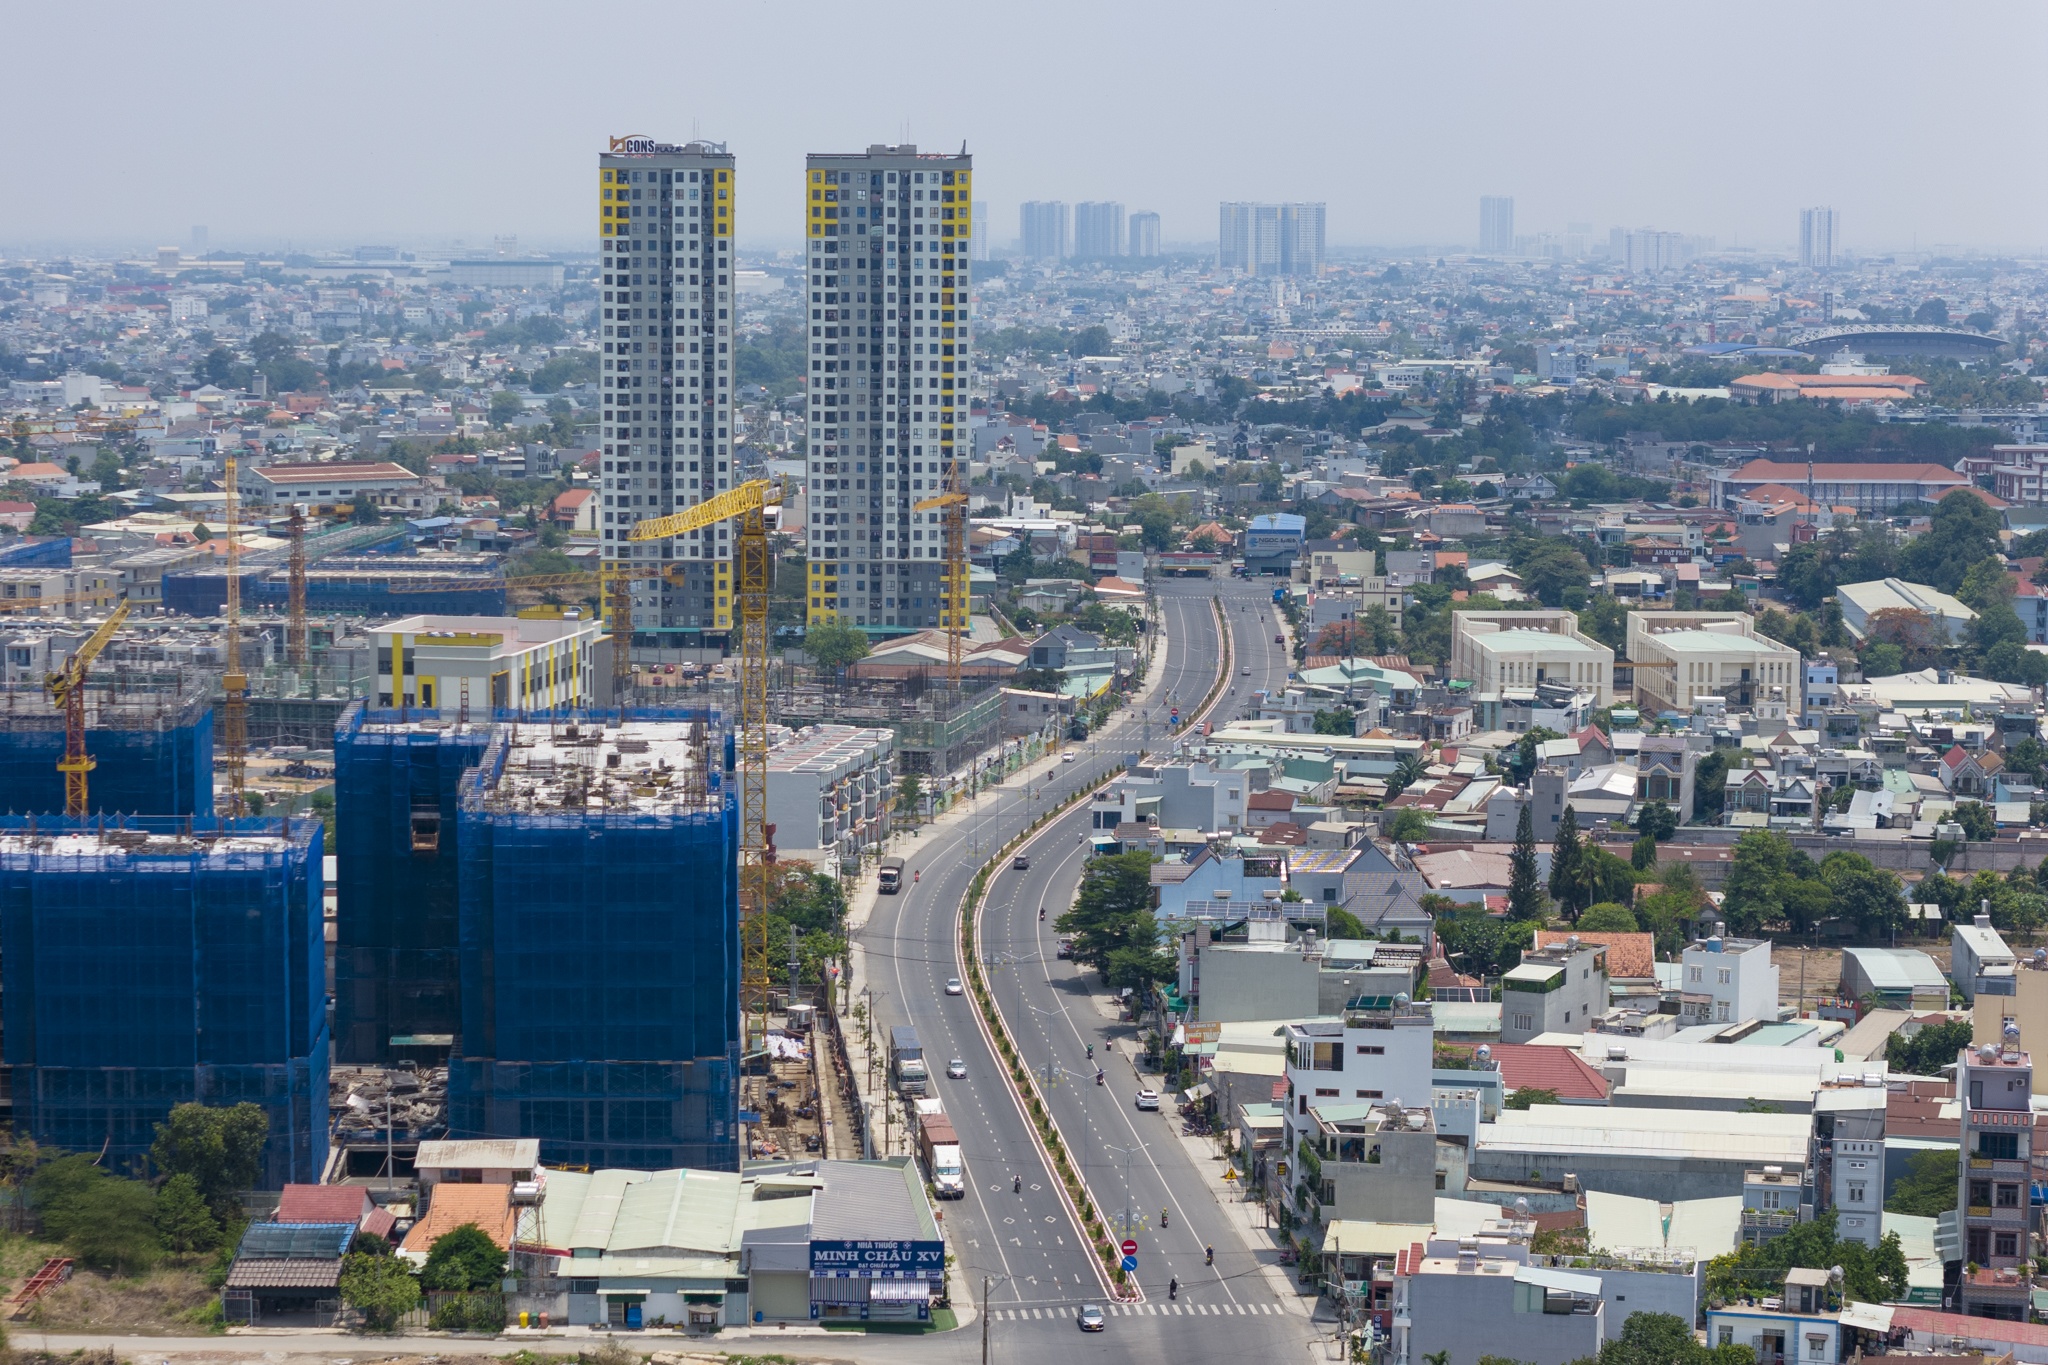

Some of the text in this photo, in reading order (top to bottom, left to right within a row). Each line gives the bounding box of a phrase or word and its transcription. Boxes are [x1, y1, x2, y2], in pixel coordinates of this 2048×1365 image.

[858, 1239, 898, 1249] NHÀ THUỐC
[814, 1249, 941, 1261] MINH CHÂU XV
